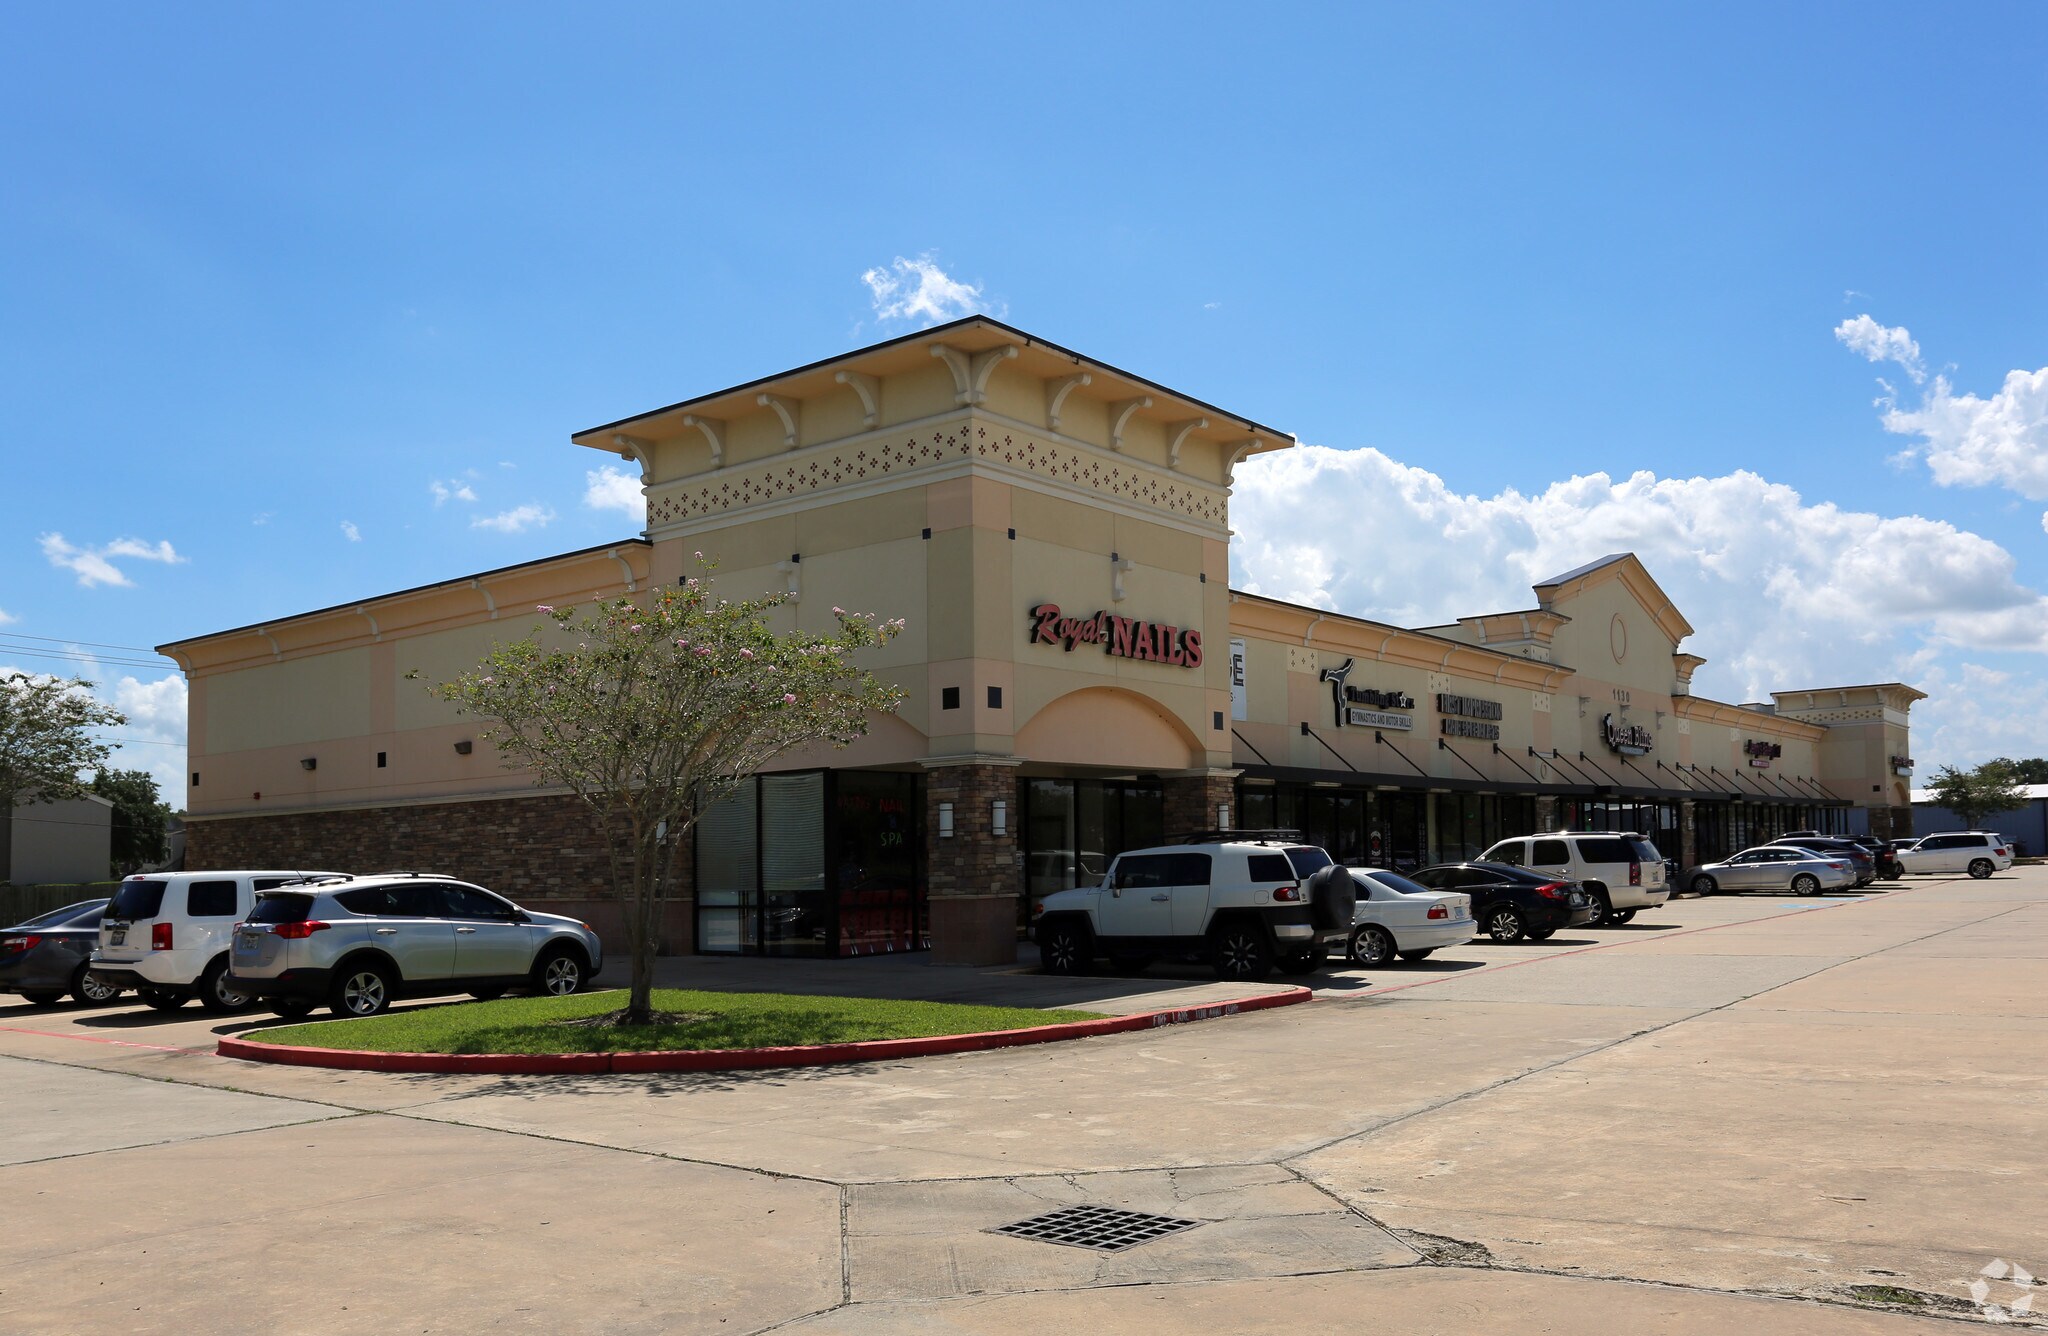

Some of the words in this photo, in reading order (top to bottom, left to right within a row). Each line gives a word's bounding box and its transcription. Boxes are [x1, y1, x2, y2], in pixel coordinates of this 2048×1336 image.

[1030, 603, 1107, 653] Royal
[1108, 615, 1203, 669] NAILS
[1347, 686, 1390, 709] Tumbling
[1612, 687, 1630, 703] 1130
[1352, 711, 1377, 723] GYMNASTICS
[1377, 714, 1385, 725] AND
[1399, 717, 1412, 728] SKILLS
[1607, 724, 1632, 747] Queen
[1633, 726, 1653, 752] Bling
[880, 832, 903, 847] SPA
[1152, 1013, 1168, 1026] FIRE
[1172, 1010, 1189, 1023] LANE
